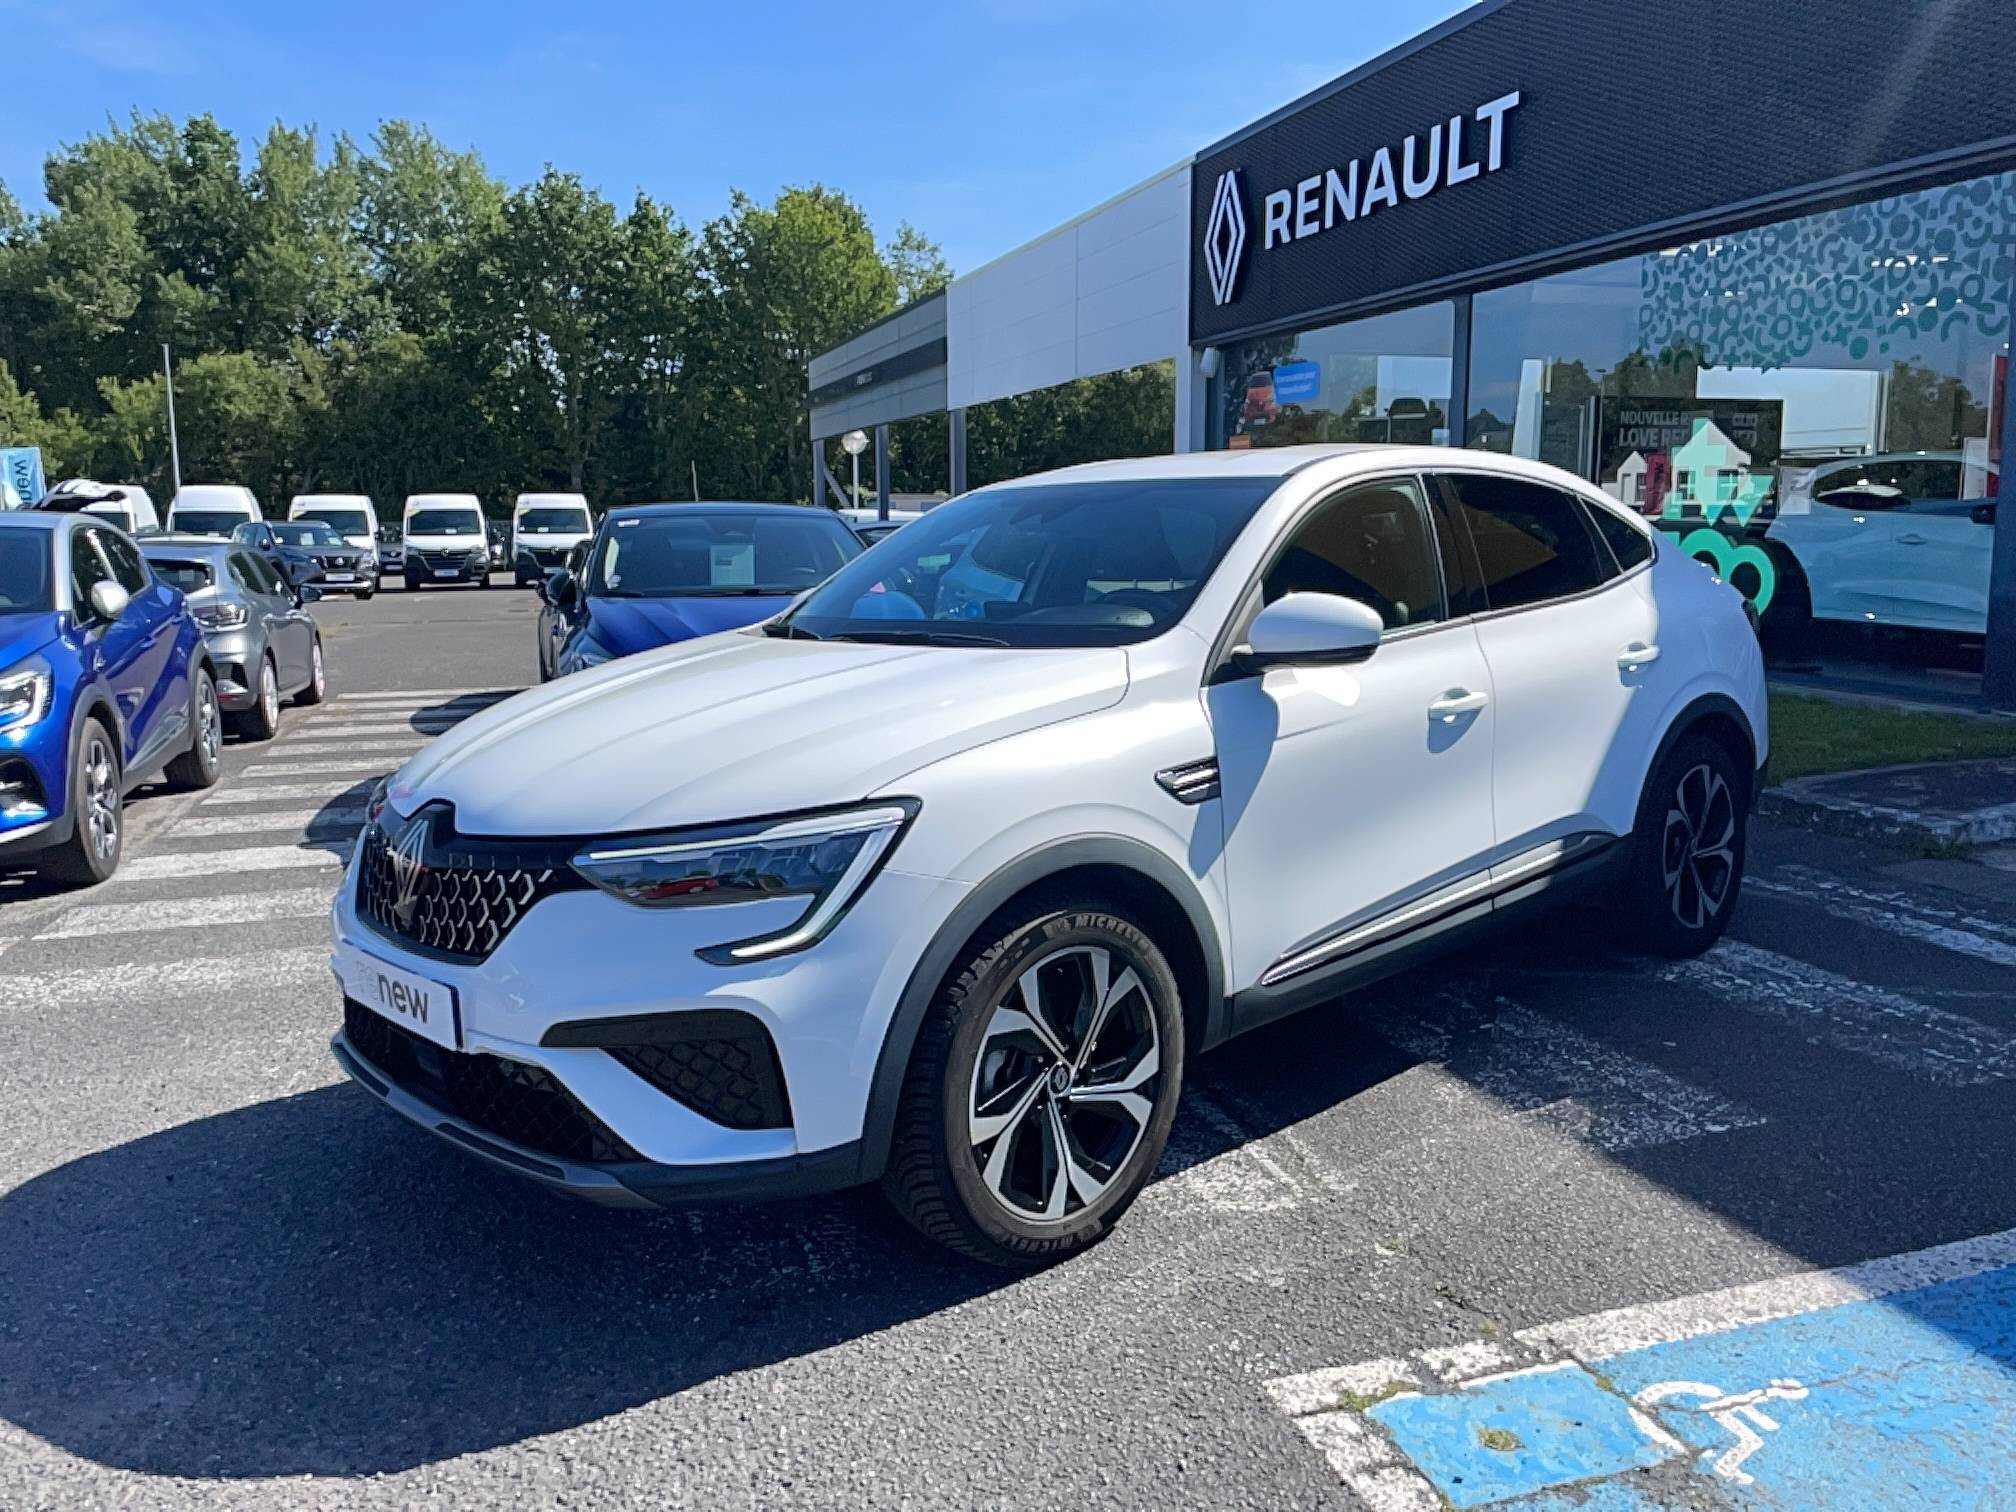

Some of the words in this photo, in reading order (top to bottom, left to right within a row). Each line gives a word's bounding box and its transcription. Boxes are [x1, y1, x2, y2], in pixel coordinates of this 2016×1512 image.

[1265, 91, 1519, 249] RENAULT
[1620, 411, 1680, 425] NOUVELLE
[1619, 427, 1658, 447] LOVE
